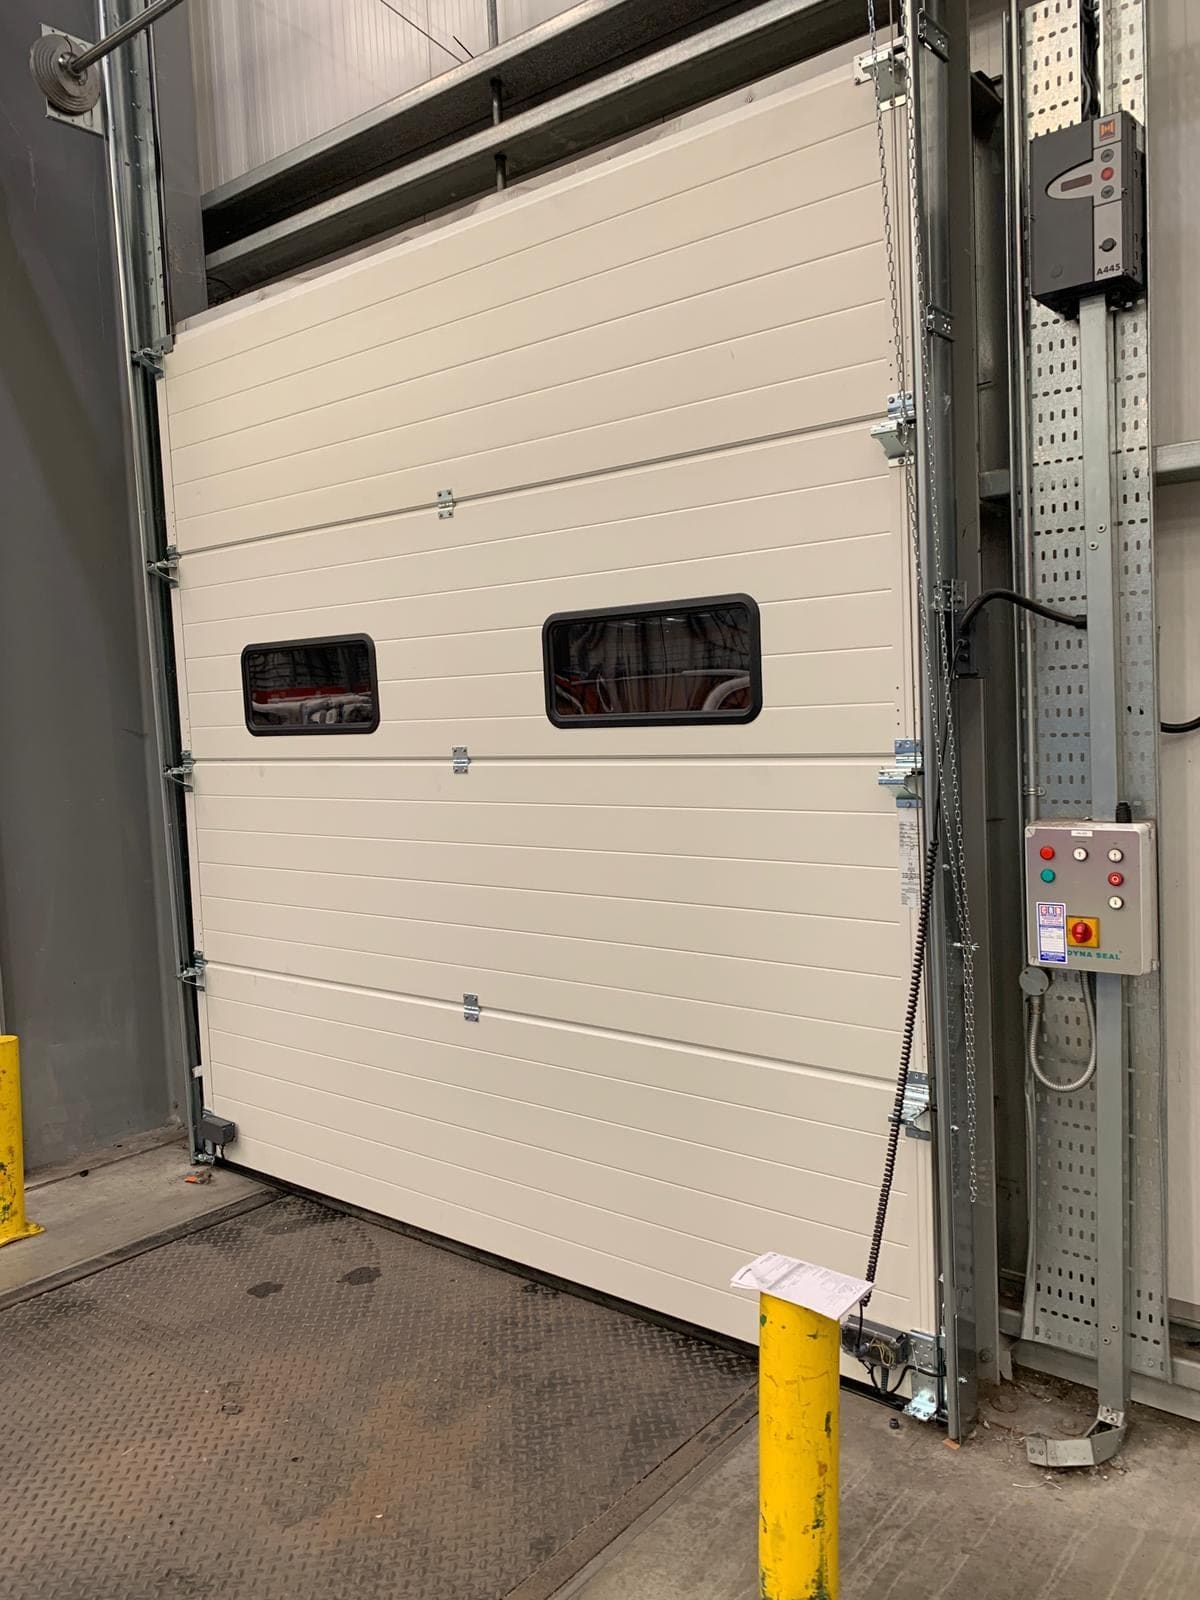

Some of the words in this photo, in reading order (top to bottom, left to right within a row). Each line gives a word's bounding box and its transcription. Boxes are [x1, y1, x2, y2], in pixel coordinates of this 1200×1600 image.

[1097, 263, 1120, 275] A445
[1067, 950, 1092, 958] DYNA
[1096, 952, 1120, 960] SEAL
